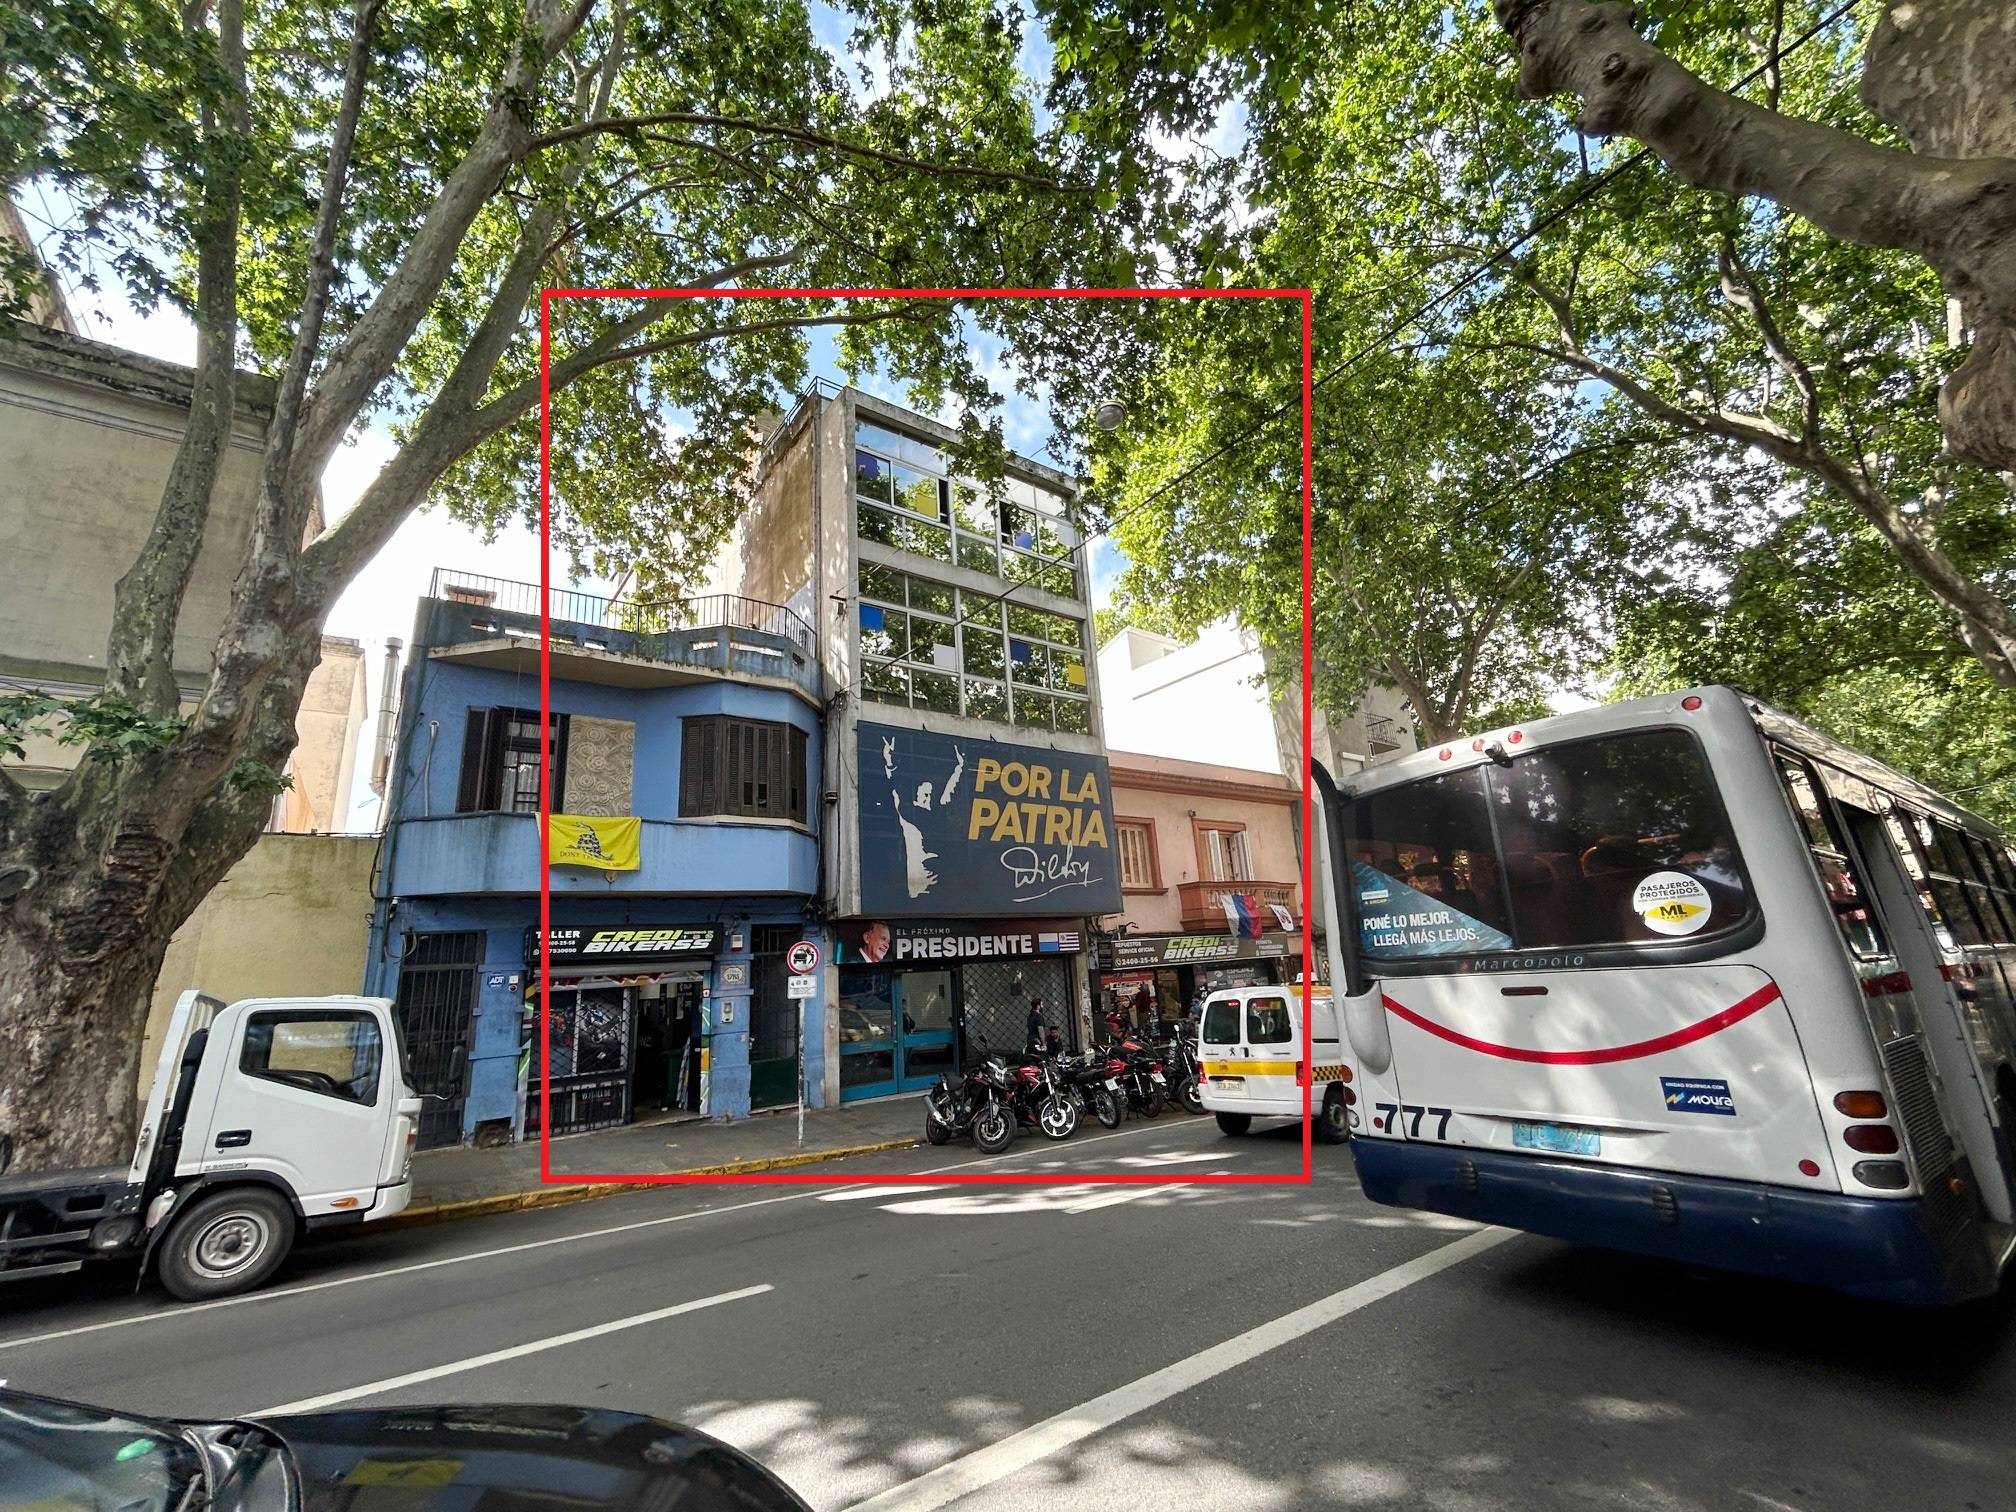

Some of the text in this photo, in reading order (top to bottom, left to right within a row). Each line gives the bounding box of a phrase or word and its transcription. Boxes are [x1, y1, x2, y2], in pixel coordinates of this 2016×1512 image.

[975, 758, 1101, 804] POR LA
[968, 798, 1108, 848] PATRIA
[1640, 886, 1700, 898] PROTEGIDOS
[1641, 880, 1696, 892] PASAJEROS
[1659, 904, 1687, 916] ML
[1363, 911, 1454, 930] PONÉ LO MEJOR.
[536, 930, 580, 939] TLLER
[896, 928, 907, 936] EL
[1373, 927, 1480, 946] LLEGÁ MÁS LEJOS.
[896, 934, 1033, 960] PRESIDENTE
[1474, 955, 1584, 971] Marcopolo
[489, 976, 505, 985] ADT
[1375, 1102, 1453, 1141] 777
